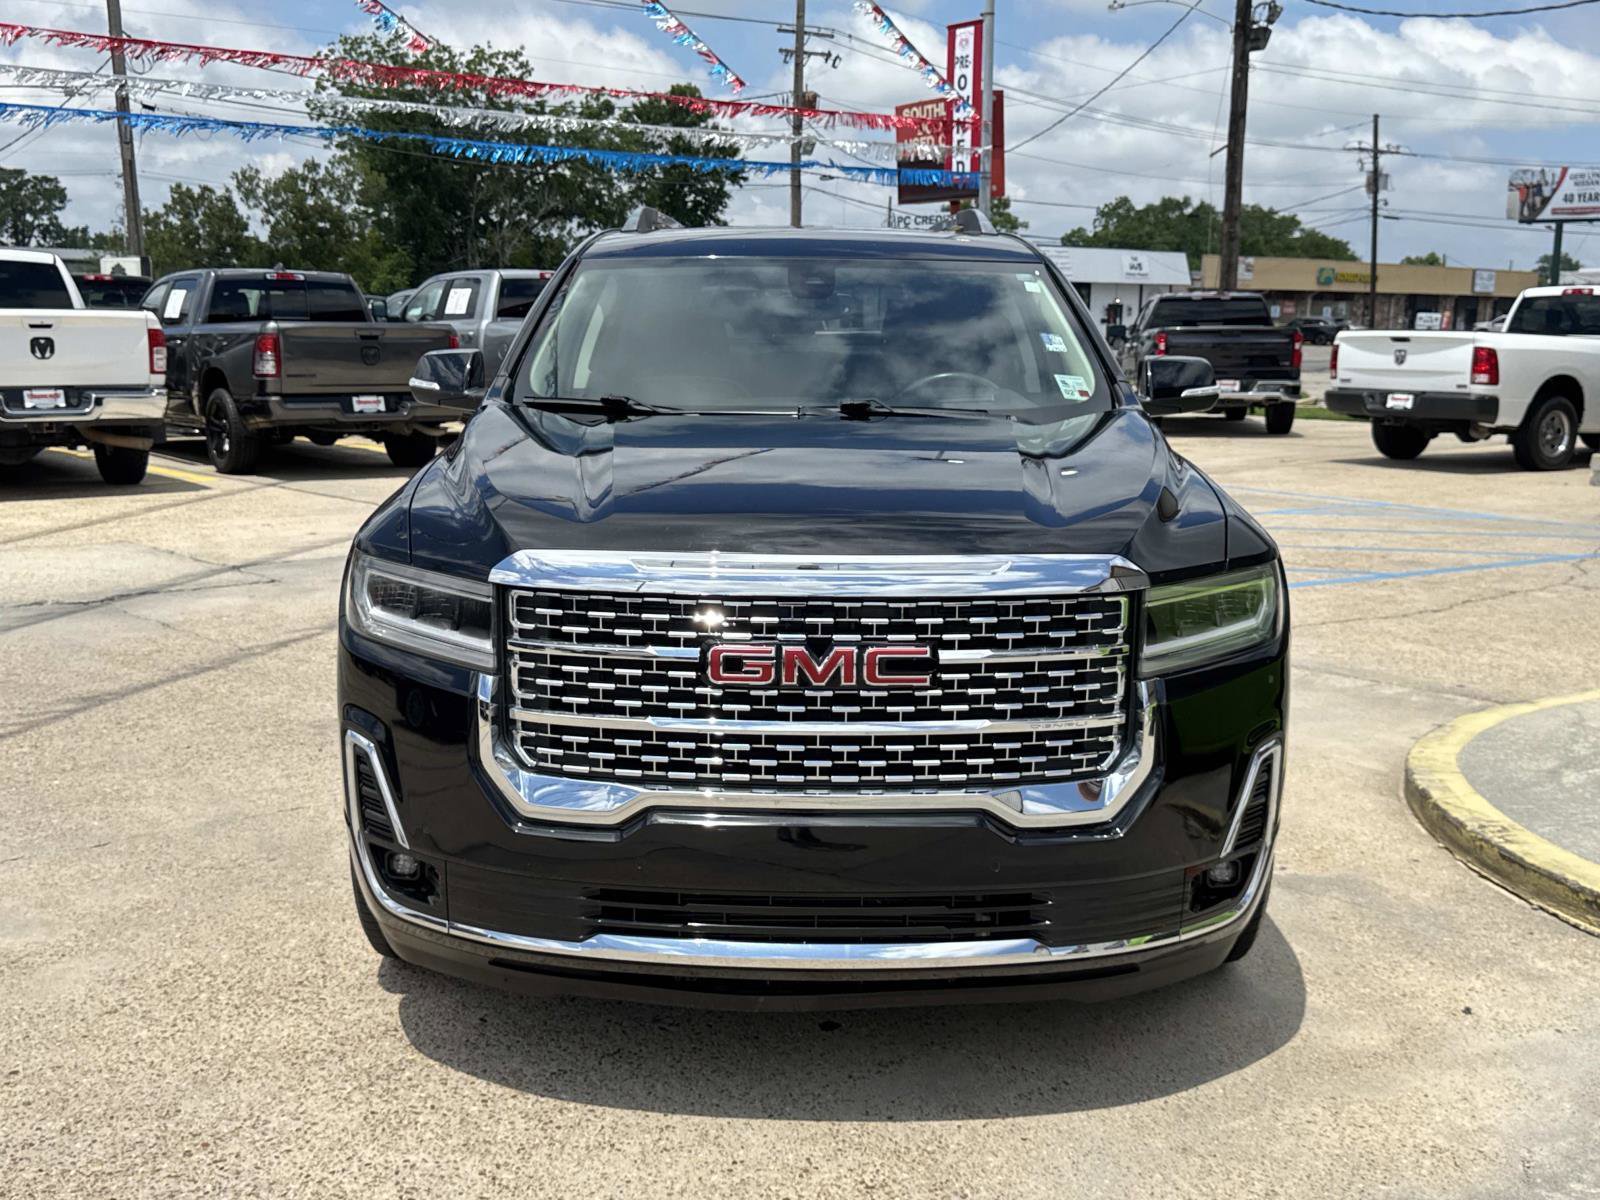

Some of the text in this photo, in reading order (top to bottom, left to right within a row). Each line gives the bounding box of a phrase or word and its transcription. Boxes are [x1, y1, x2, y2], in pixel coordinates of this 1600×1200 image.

[956, 75, 970, 172] ONED
[1577, 191, 1600, 202] YEAR
[708, 645, 930, 685] GMC
